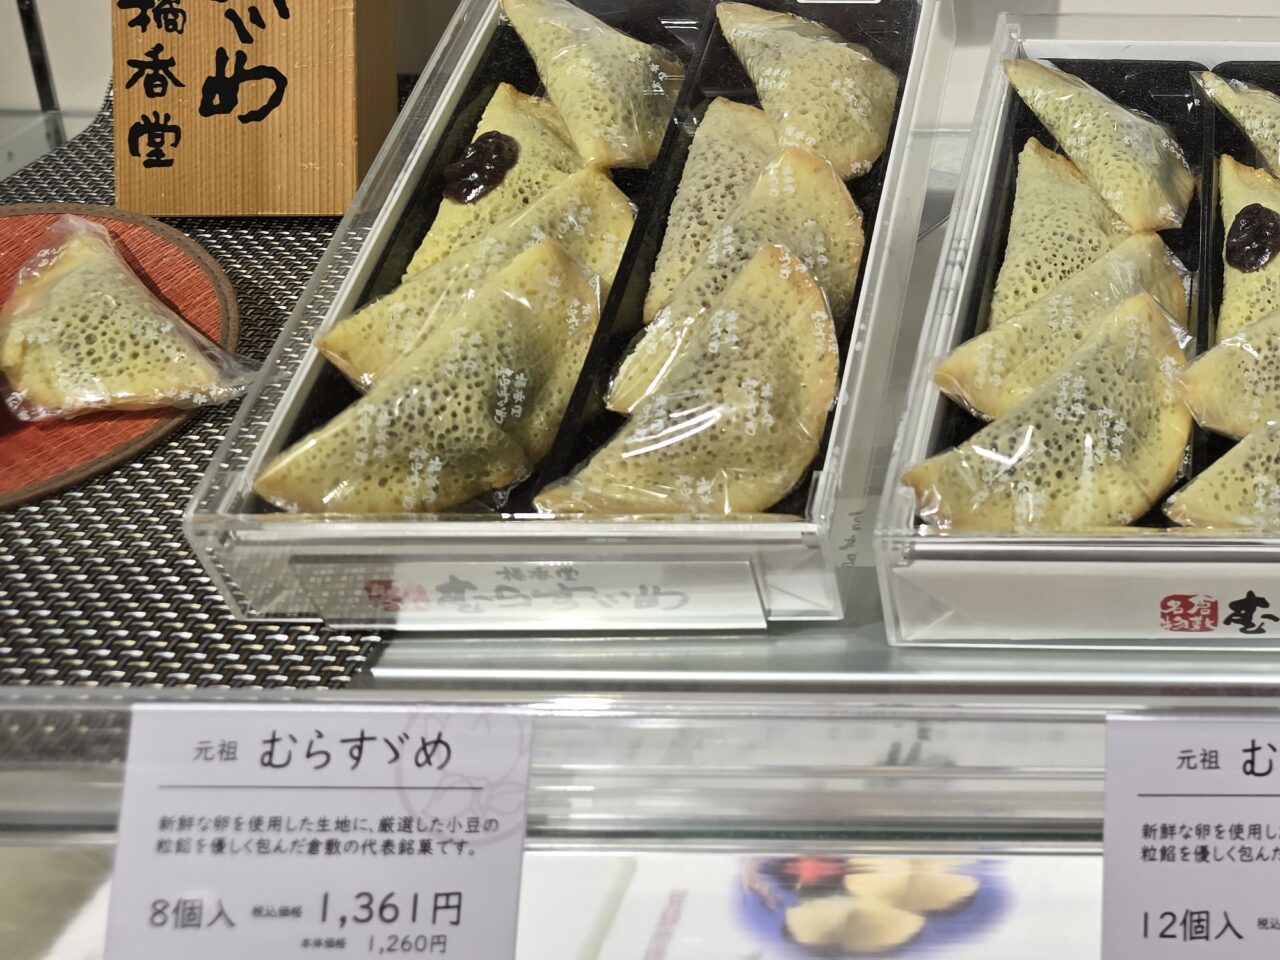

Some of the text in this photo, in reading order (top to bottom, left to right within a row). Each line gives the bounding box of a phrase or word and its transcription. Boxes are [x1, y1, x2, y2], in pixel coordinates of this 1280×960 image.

[194, 730, 451, 770] 元祖 むらすゞめ
[1178, 749, 1220, 769] 元祖
[155, 814, 501, 836] 新鮮な卵を使用した生地に、厳選した小豆の
[153, 837, 478, 858] 粒餡を優しく包んだ倉敷の代表銘菓です。
[147, 897, 238, 930] 8個入
[322, 892, 462, 928] 1,361円
[1144, 910, 1243, 941] 12個入
[365, 933, 450, 957] 1,260円
